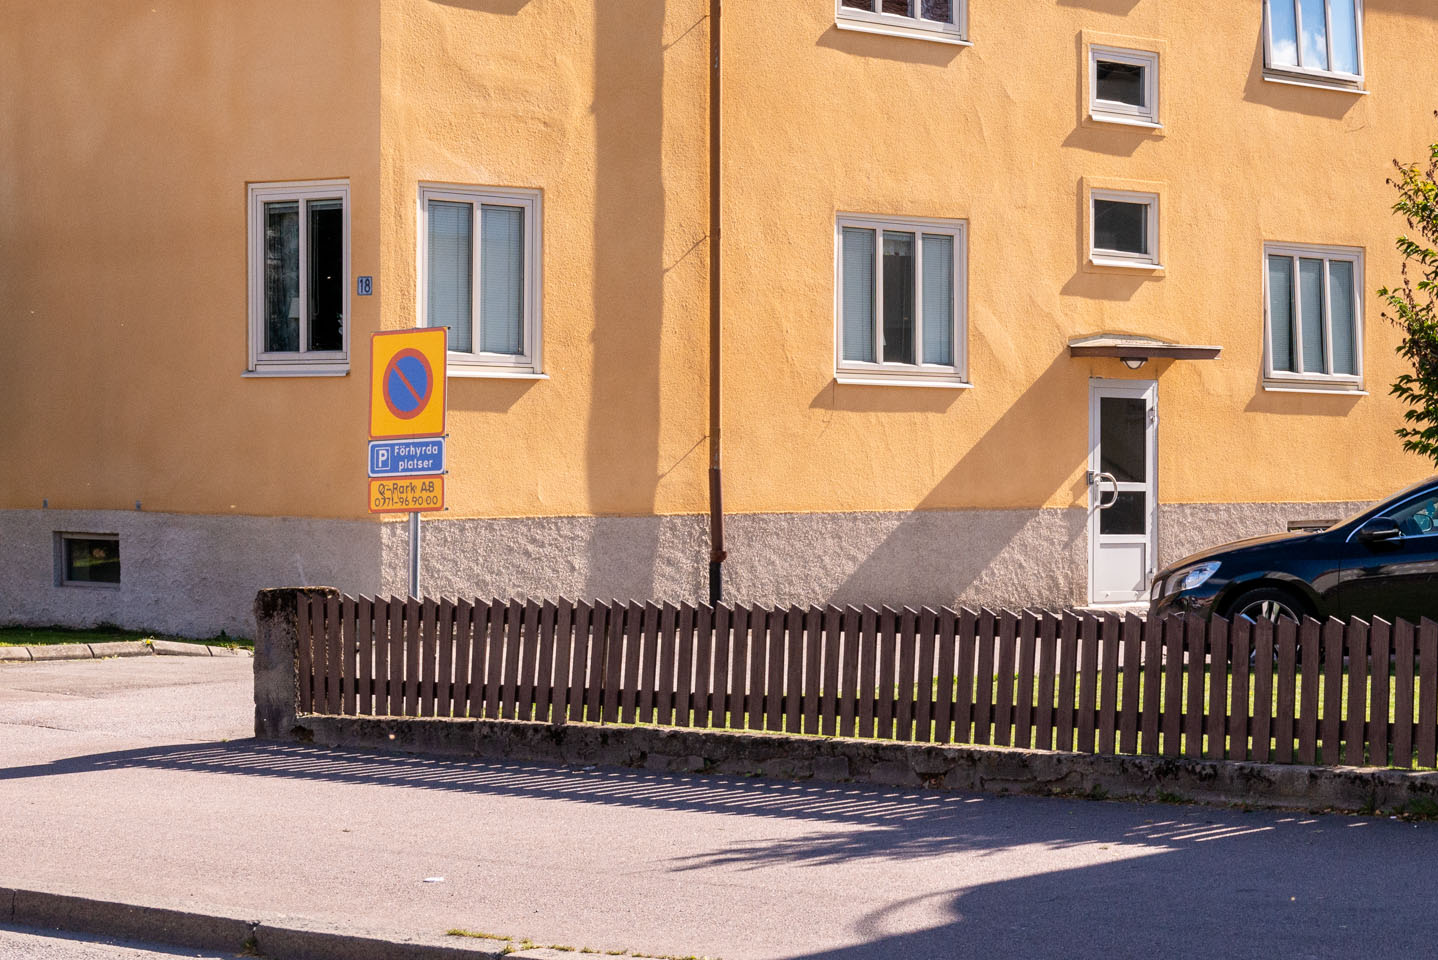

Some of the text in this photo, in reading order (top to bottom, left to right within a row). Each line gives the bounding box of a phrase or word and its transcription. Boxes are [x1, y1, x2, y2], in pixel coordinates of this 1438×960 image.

[360, 278, 371, 293] 18
[394, 444, 439, 458] Förhyrda
[378, 449, 388, 468] P
[398, 458, 433, 472] platser
[378, 480, 435, 497] Q-Park AB
[374, 495, 439, 508] 0771-96 90 00
